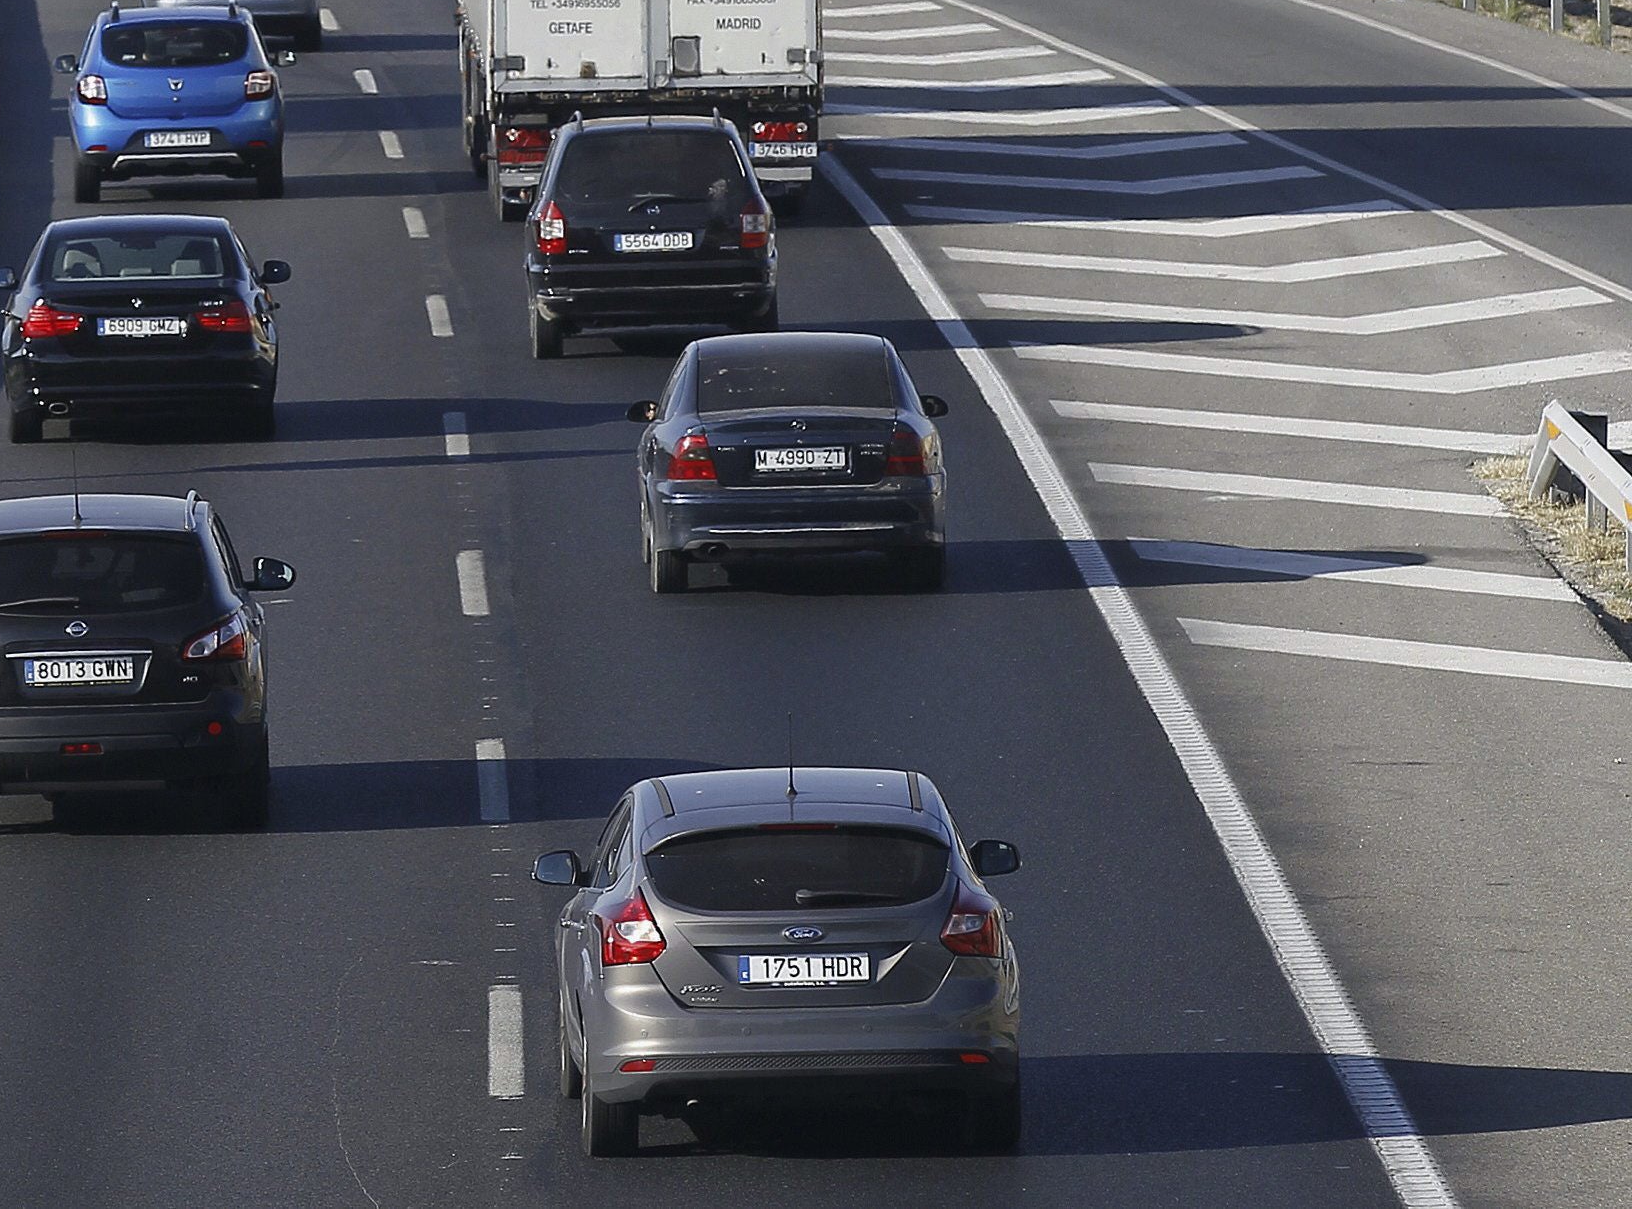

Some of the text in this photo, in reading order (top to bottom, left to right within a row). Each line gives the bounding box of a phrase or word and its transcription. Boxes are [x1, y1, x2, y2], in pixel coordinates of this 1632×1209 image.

[529, 0, 549, 10] TEL
[548, 21, 594, 35] GETAFE
[716, 17, 762, 31] MADRID
[624, 234, 660, 249] 5564
[108, 318, 144, 333] 6909
[37, 658, 129, 679] 8013 GWN
[793, 928, 815, 939] Ford
[762, 956, 864, 979] 1751 HDR
